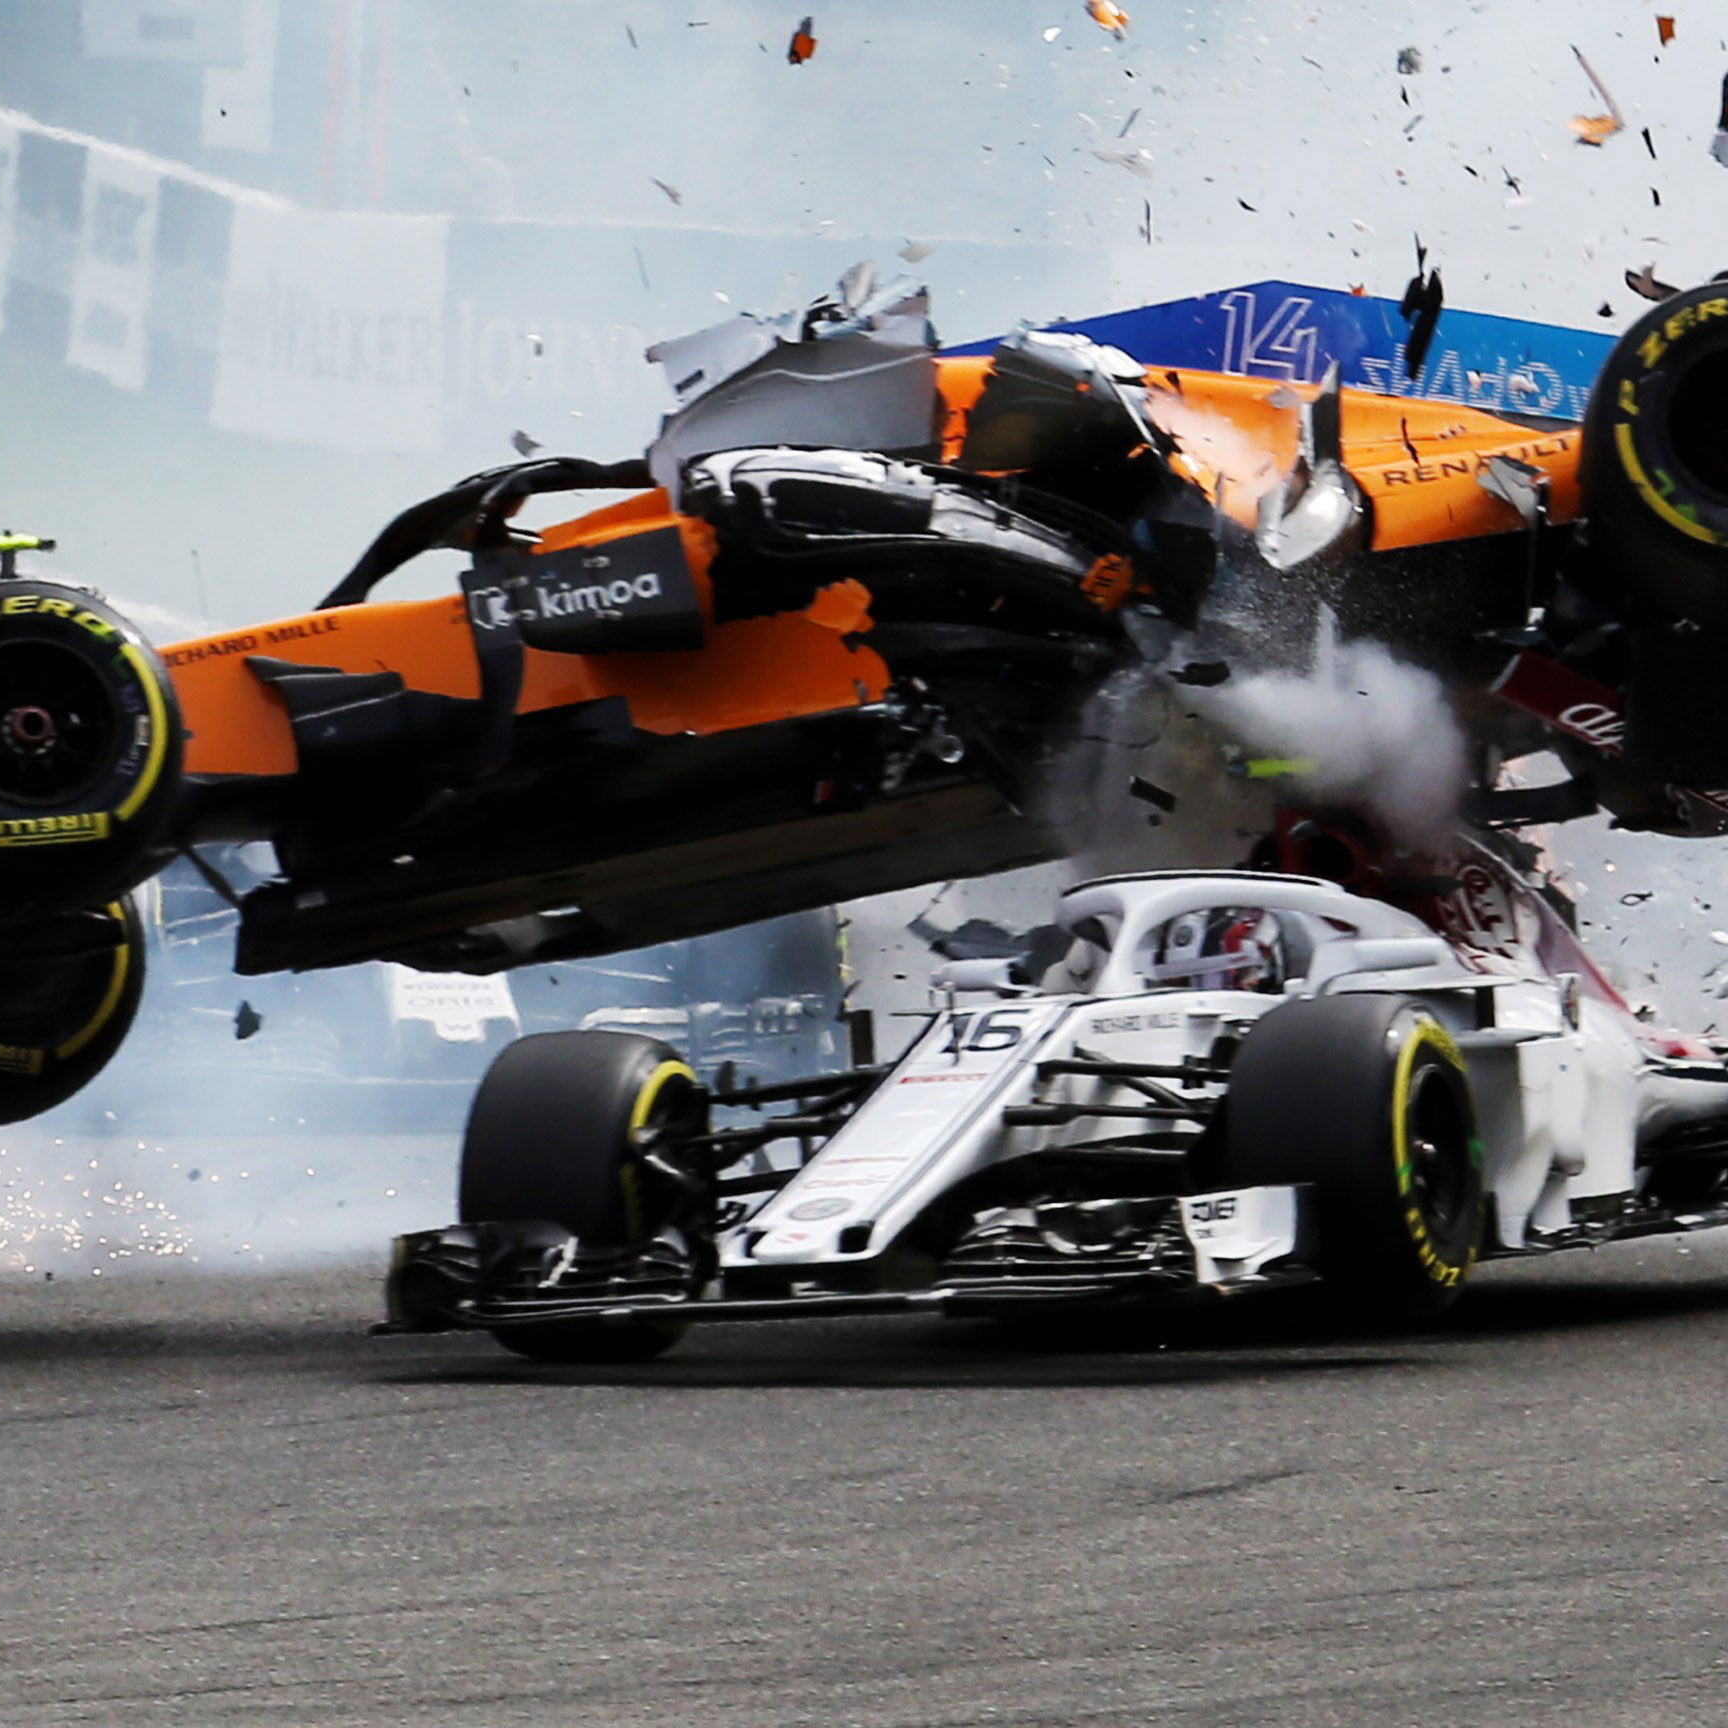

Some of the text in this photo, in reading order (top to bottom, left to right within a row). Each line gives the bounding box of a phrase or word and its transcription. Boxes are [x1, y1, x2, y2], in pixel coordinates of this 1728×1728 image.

[1220, 291, 1318, 384] 14
[535, 573, 663, 618] kimoa
[163, 616, 340, 668] ICHARD MILLE
[940, 1009, 1032, 1054] 16
